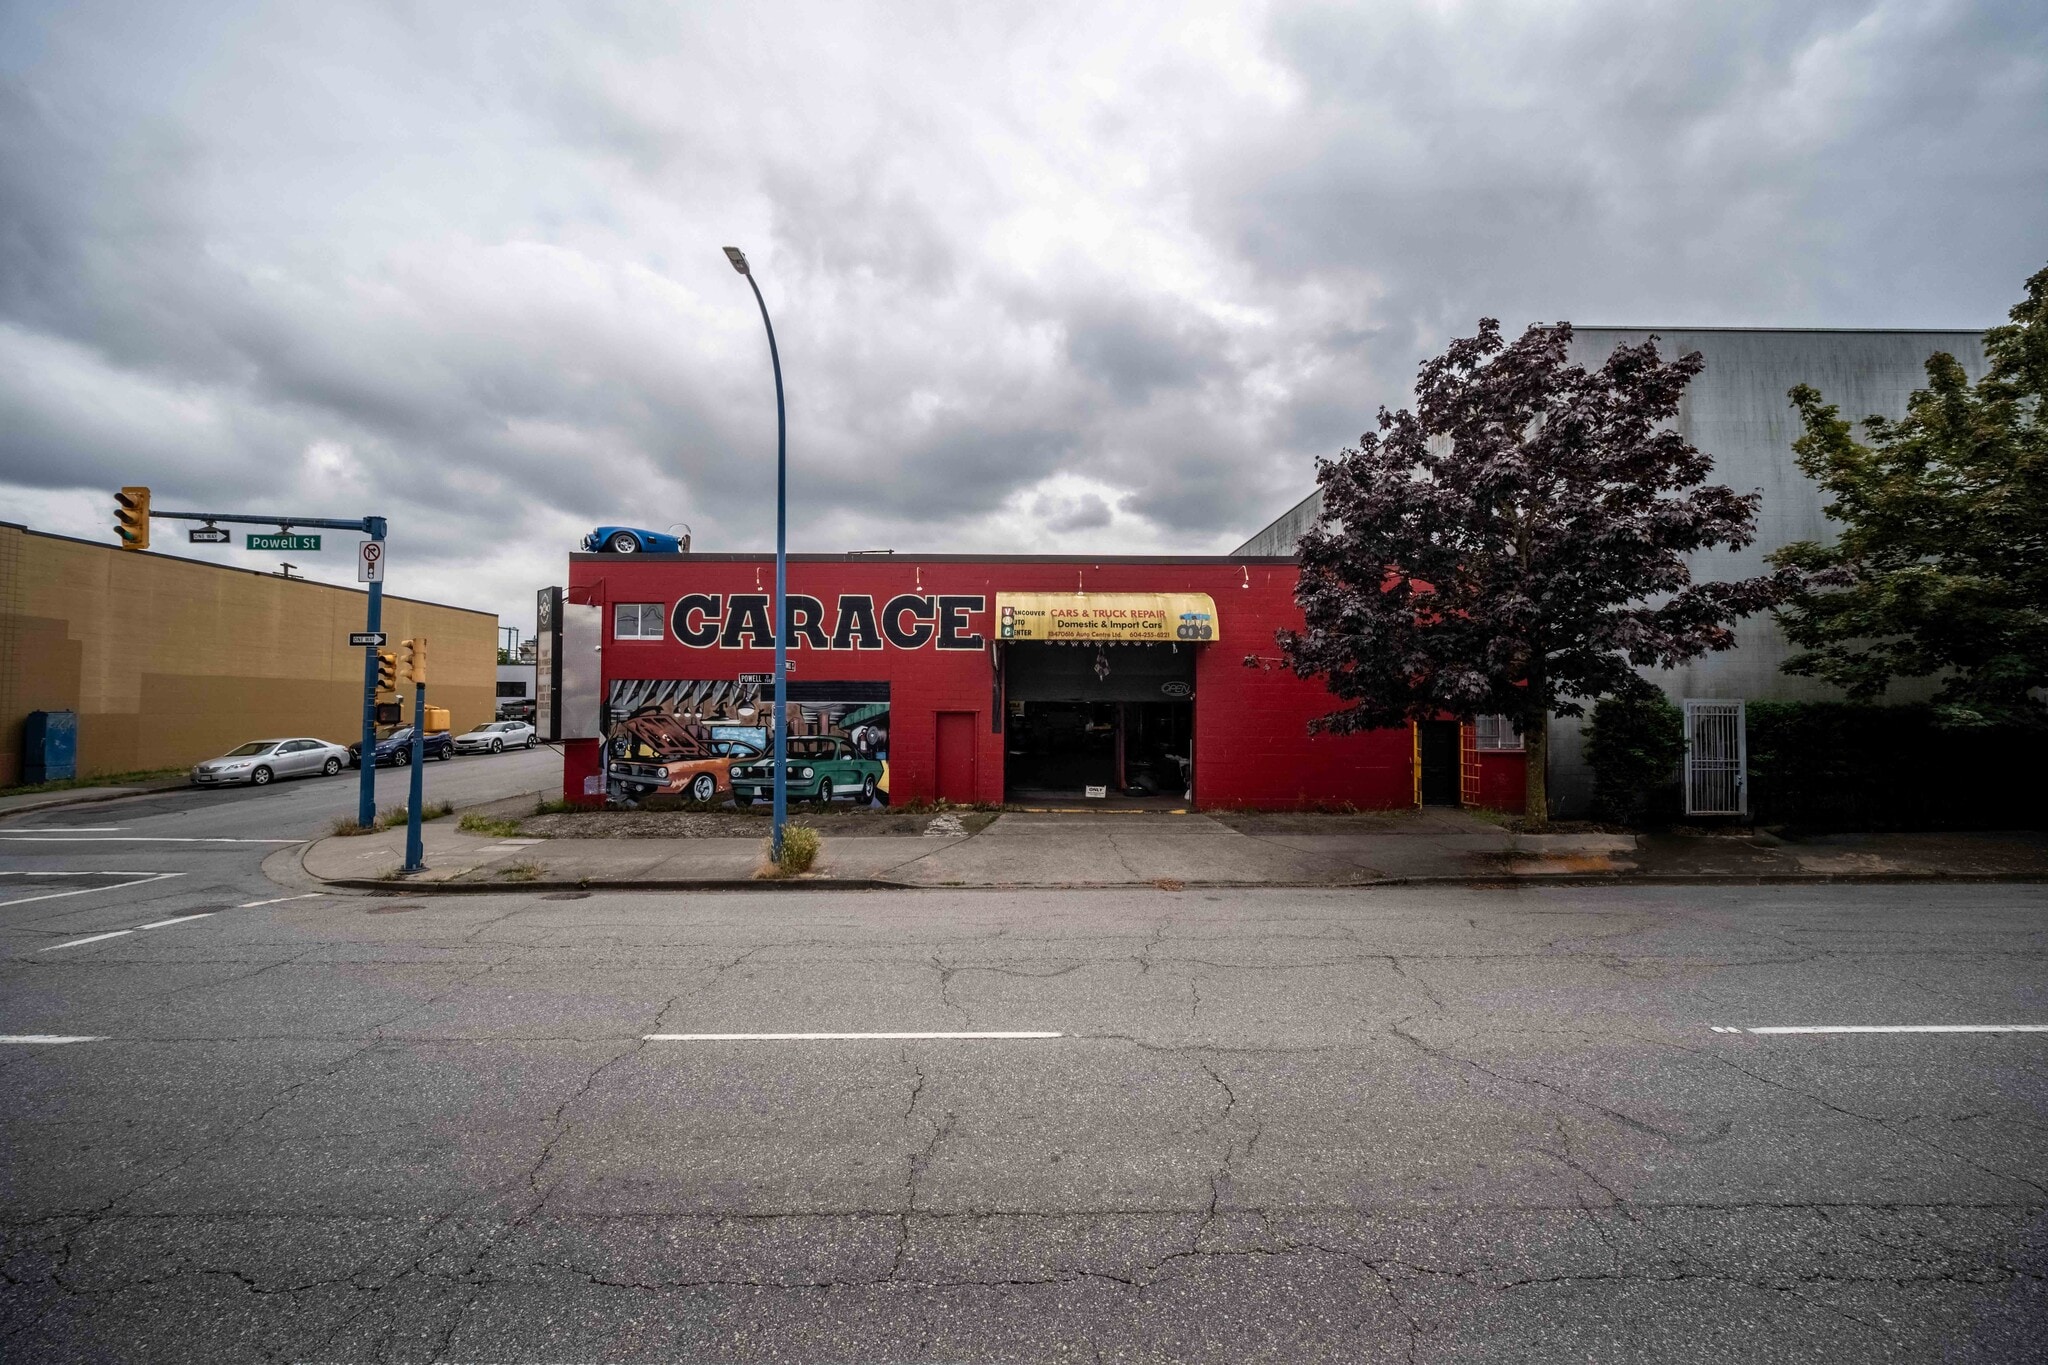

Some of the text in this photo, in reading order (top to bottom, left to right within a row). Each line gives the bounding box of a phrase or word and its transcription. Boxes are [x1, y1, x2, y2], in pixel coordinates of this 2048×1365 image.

[252, 537, 315, 548] Powell St
[1050, 609, 1166, 618] CARS & TRUCK REPAIR
[670, 593, 986, 651] GARAGE
[1057, 620, 1162, 630] Domestic & Import Cars
[1163, 684, 1191, 693] OPEN
